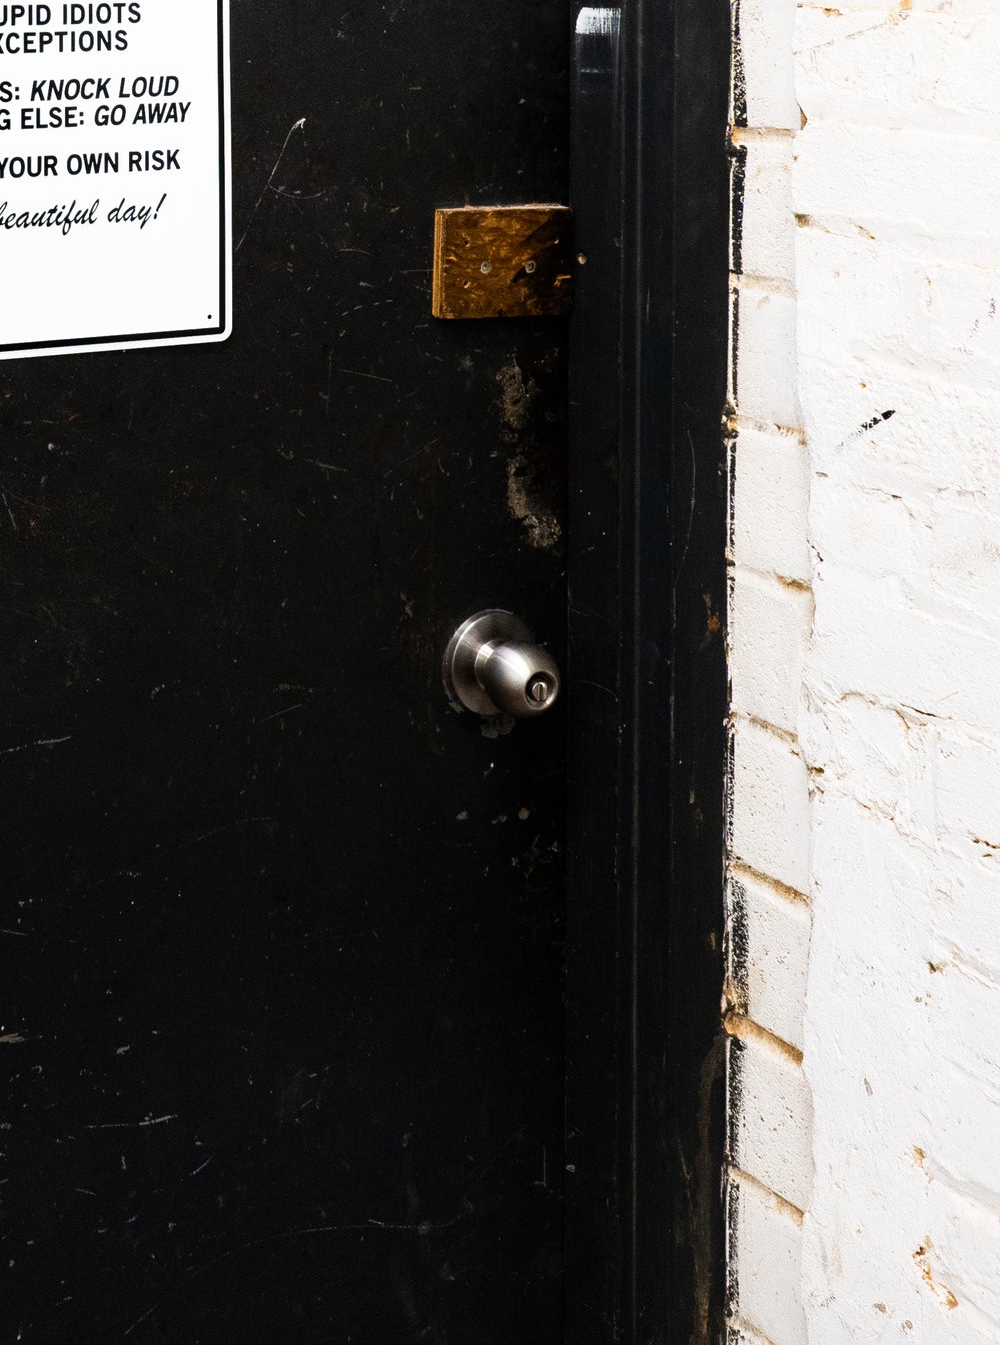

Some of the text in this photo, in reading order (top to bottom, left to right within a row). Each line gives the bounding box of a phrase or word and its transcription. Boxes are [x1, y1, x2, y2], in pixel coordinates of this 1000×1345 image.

[63, 3, 141, 25] IDIOTS
[31, 78, 111, 101] KNOCK
[119, 76, 179, 98] LOUD
[21, 106, 84, 129] ELSE:
[95, 104, 126, 126] GO
[132, 102, 191, 124] AWAY
[67, 152, 118, 175] OWN
[129, 149, 180, 172] RISK
[108, 193, 167, 229] day!
